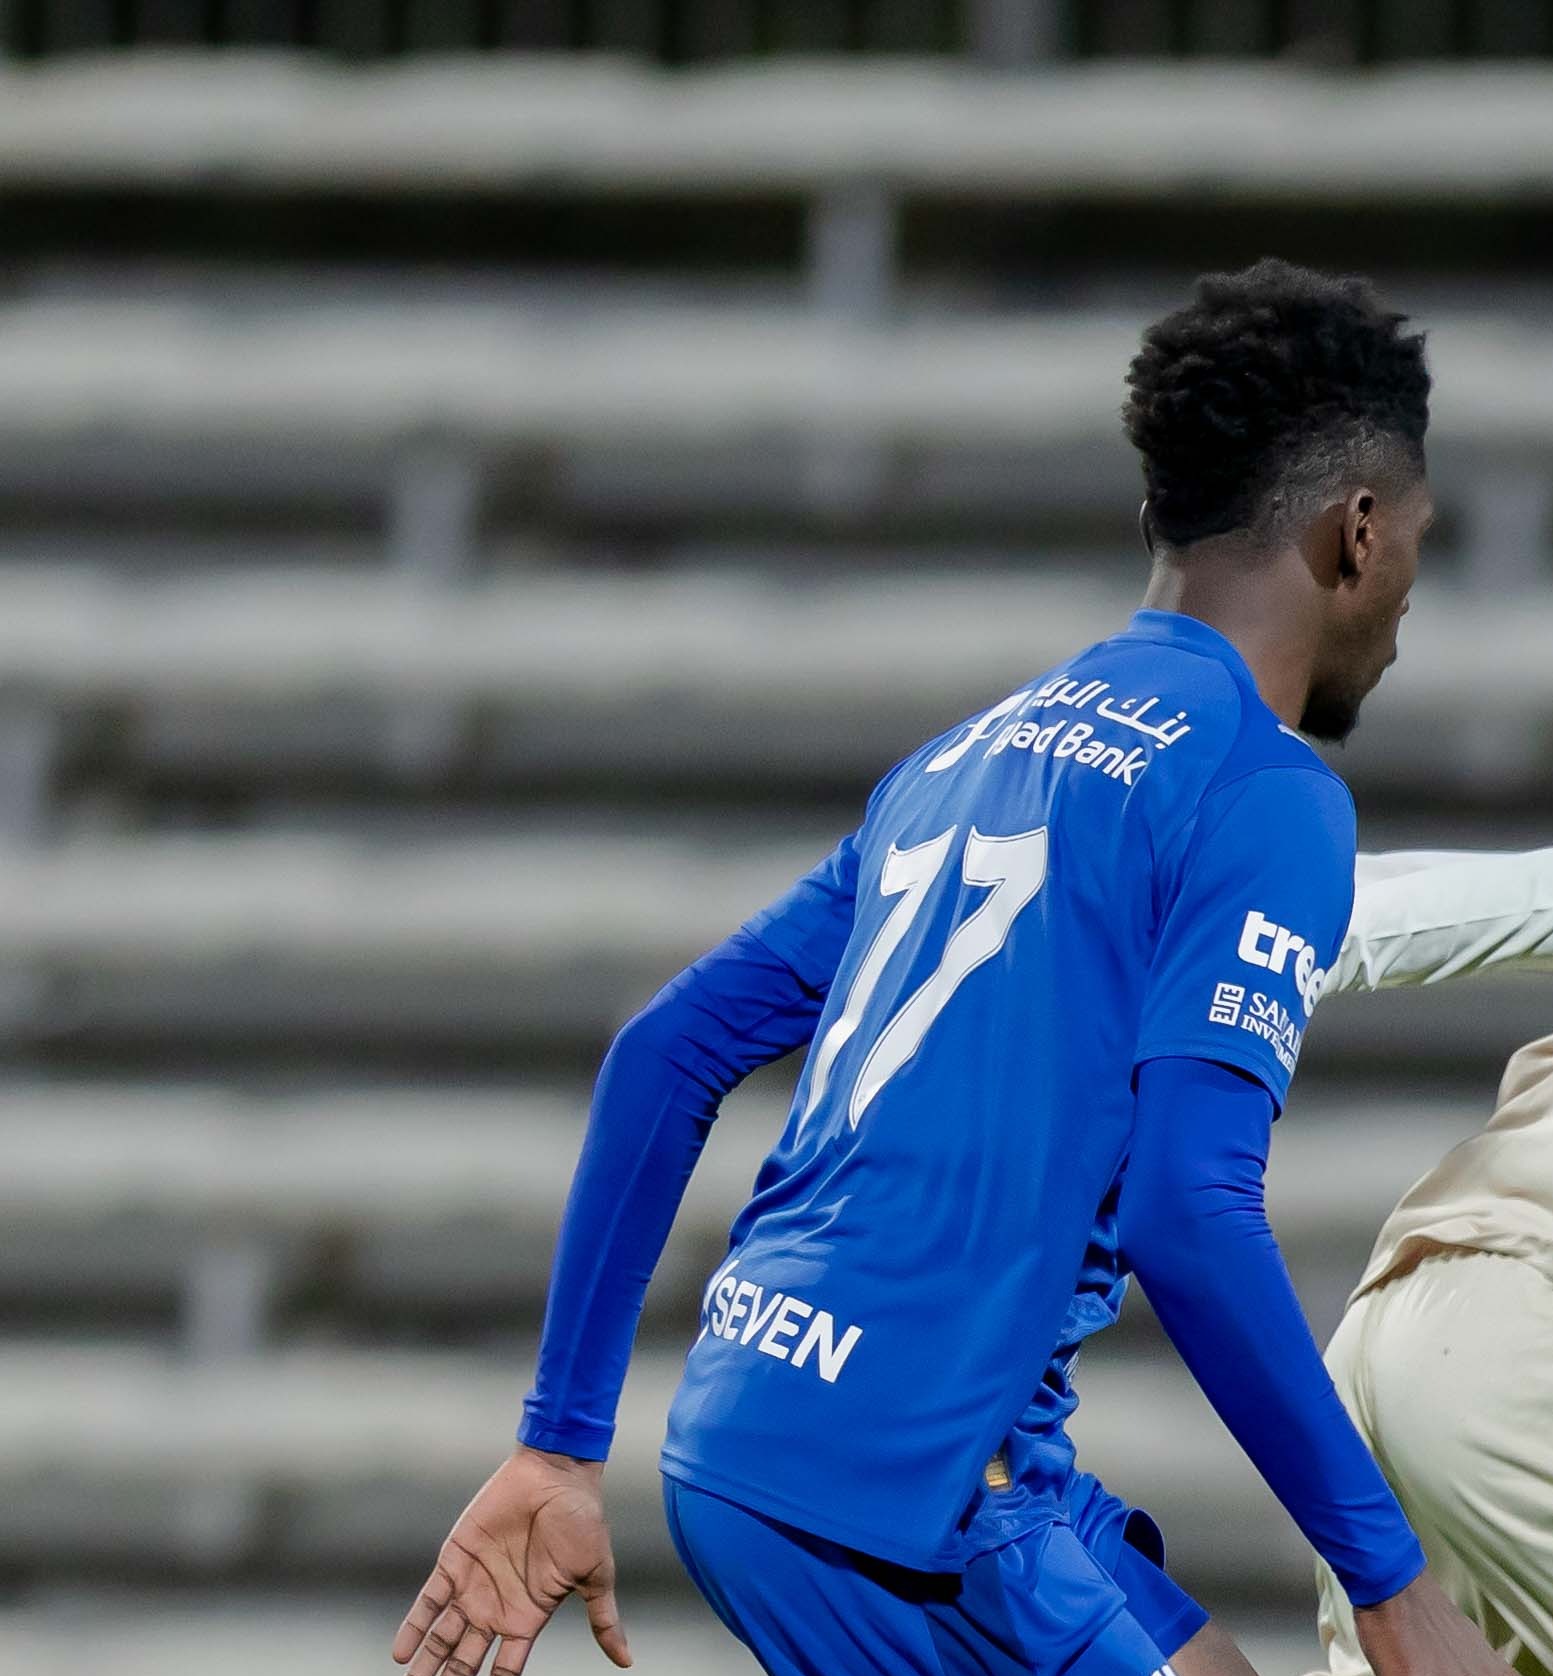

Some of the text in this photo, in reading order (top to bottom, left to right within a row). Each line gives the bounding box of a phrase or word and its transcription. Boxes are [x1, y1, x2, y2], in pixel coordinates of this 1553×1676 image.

[1053, 722, 1147, 786] Bank
[1097, 697, 1191, 750] بنك
[793, 824, 1048, 1150] 77
[1238, 911, 1325, 1018] tree
[712, 1276, 863, 1383] SEVEN
